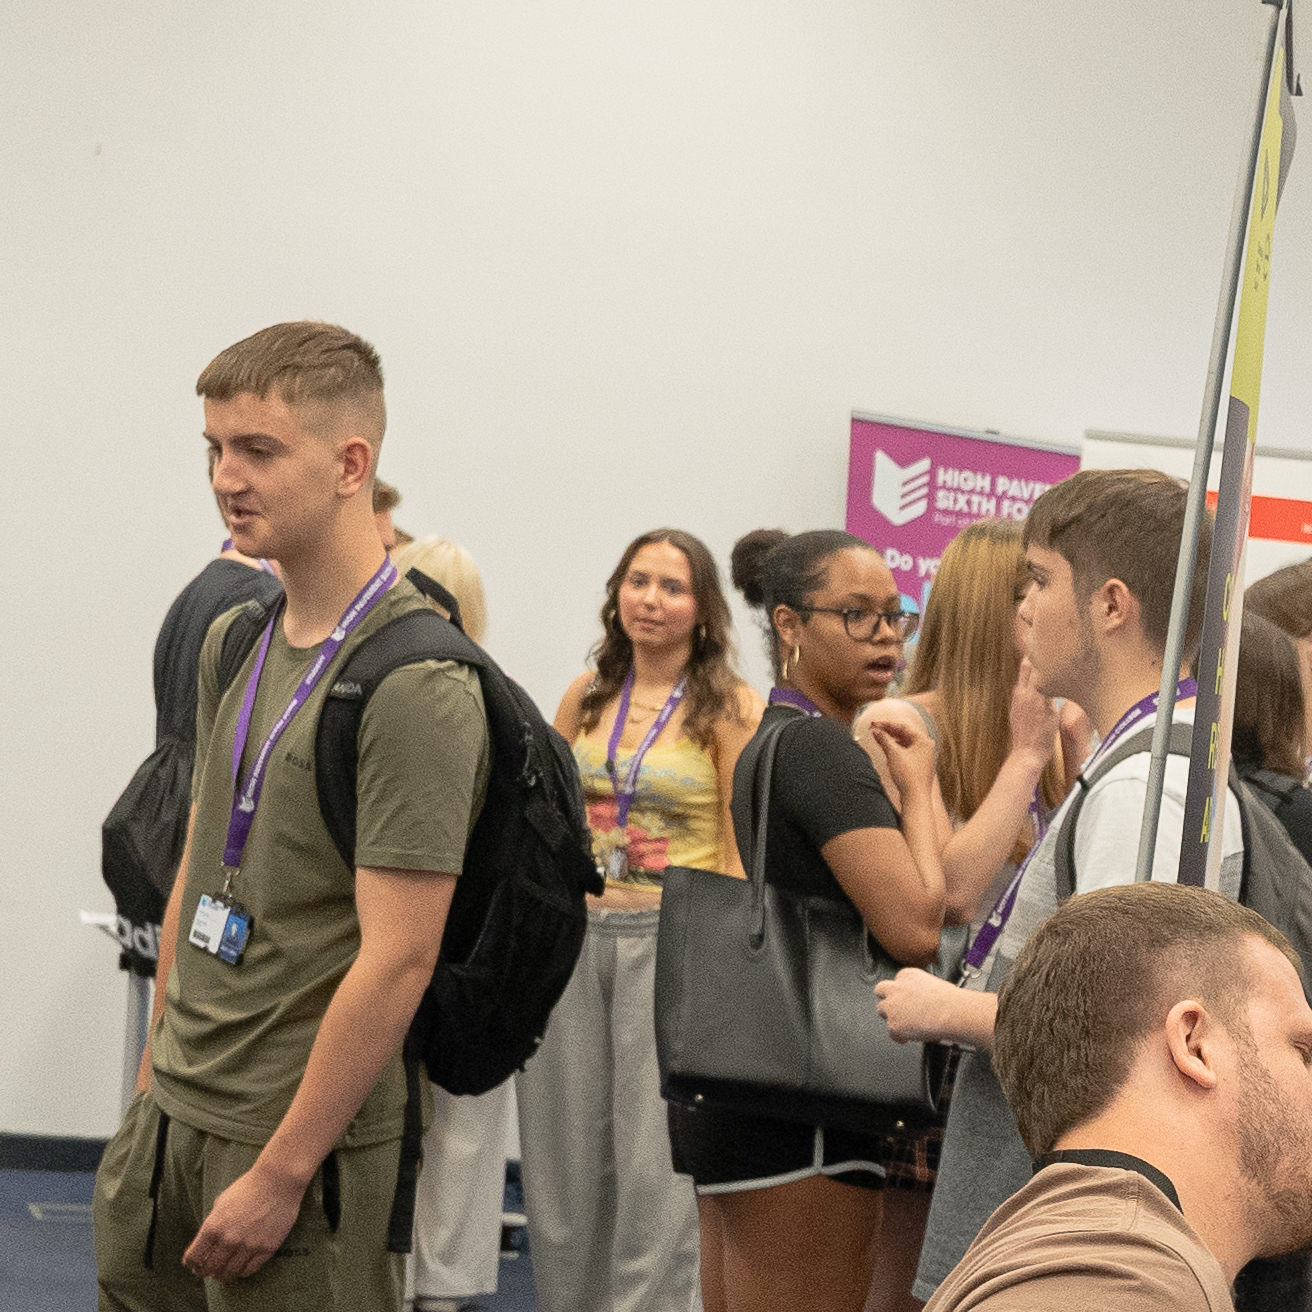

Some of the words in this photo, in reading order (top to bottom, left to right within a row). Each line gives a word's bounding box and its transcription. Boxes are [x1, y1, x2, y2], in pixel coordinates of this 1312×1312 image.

[937, 467, 992, 493] HIGH
[995, 475, 1051, 500] PAVE
[935, 491, 997, 516] SIXTH
[1000, 500, 1030, 521] FO
[885, 549, 913, 571] Do
[918, 557, 941, 577] yo
